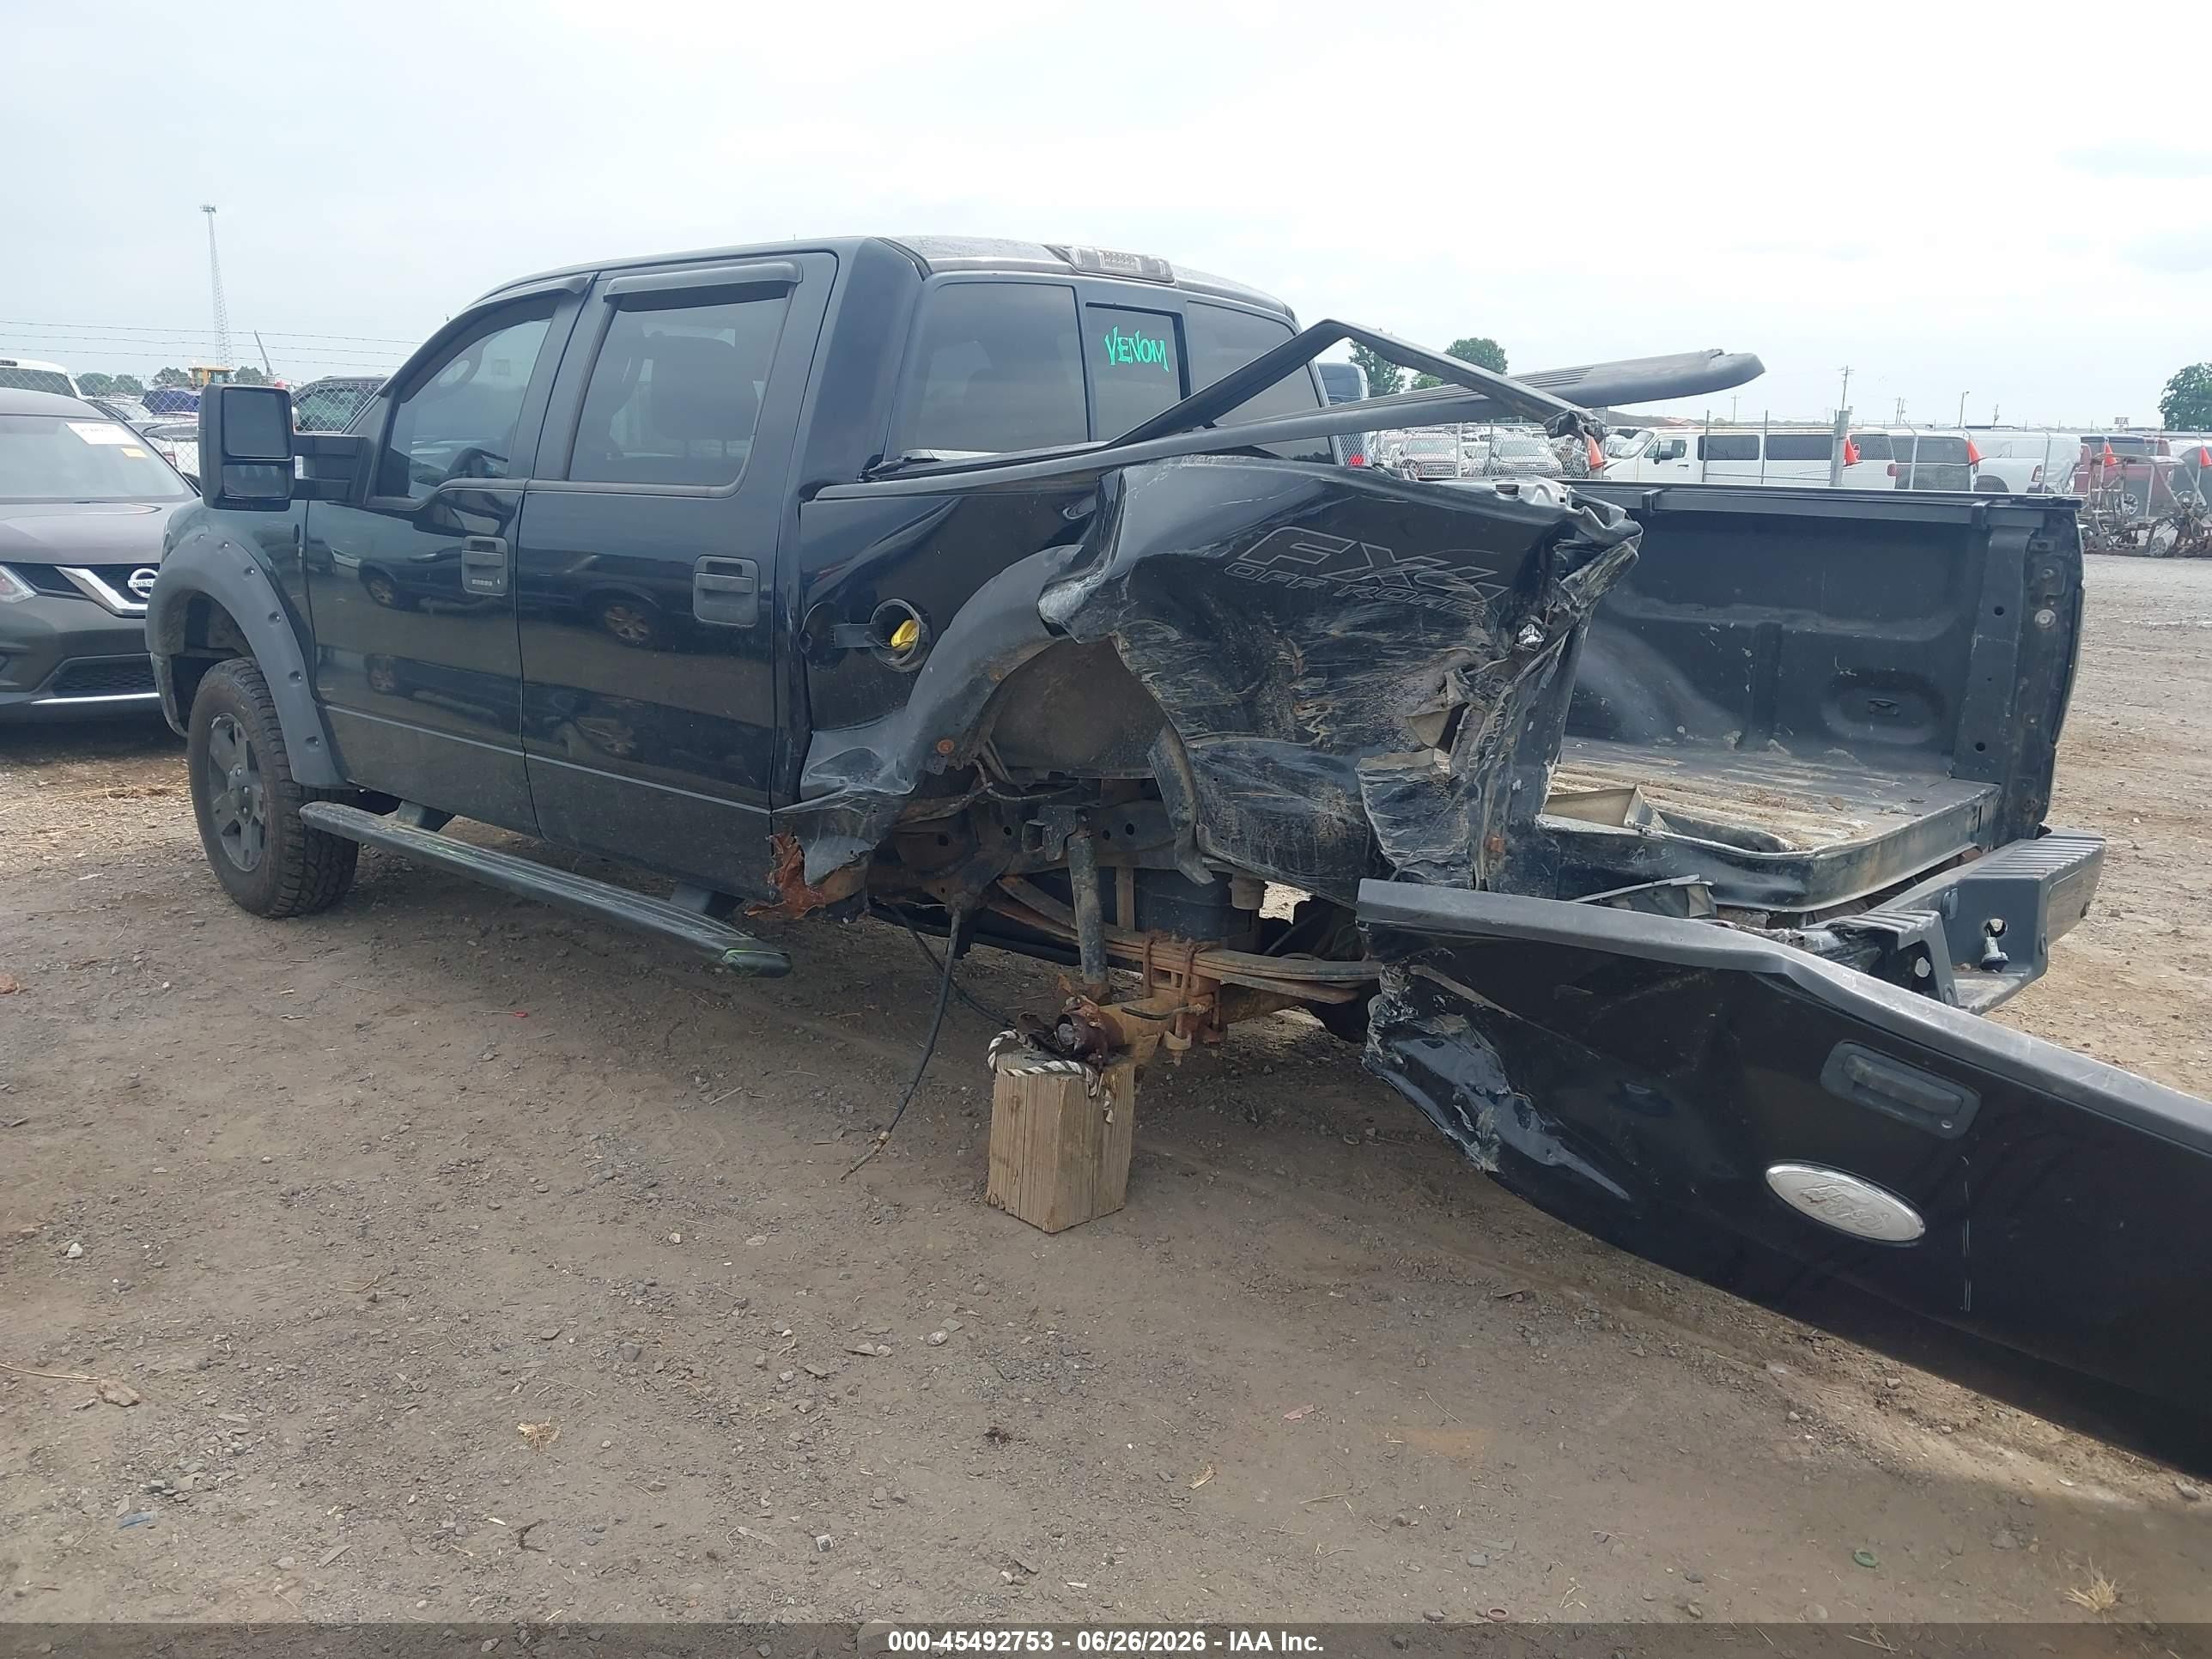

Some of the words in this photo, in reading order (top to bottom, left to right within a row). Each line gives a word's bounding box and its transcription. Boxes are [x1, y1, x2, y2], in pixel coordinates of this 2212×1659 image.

[1104, 325, 1170, 373] VENOM
[1223, 562, 1328, 590] OFF
[1237, 526, 1510, 603] FX4
[1800, 1182, 1891, 1231] Ford
